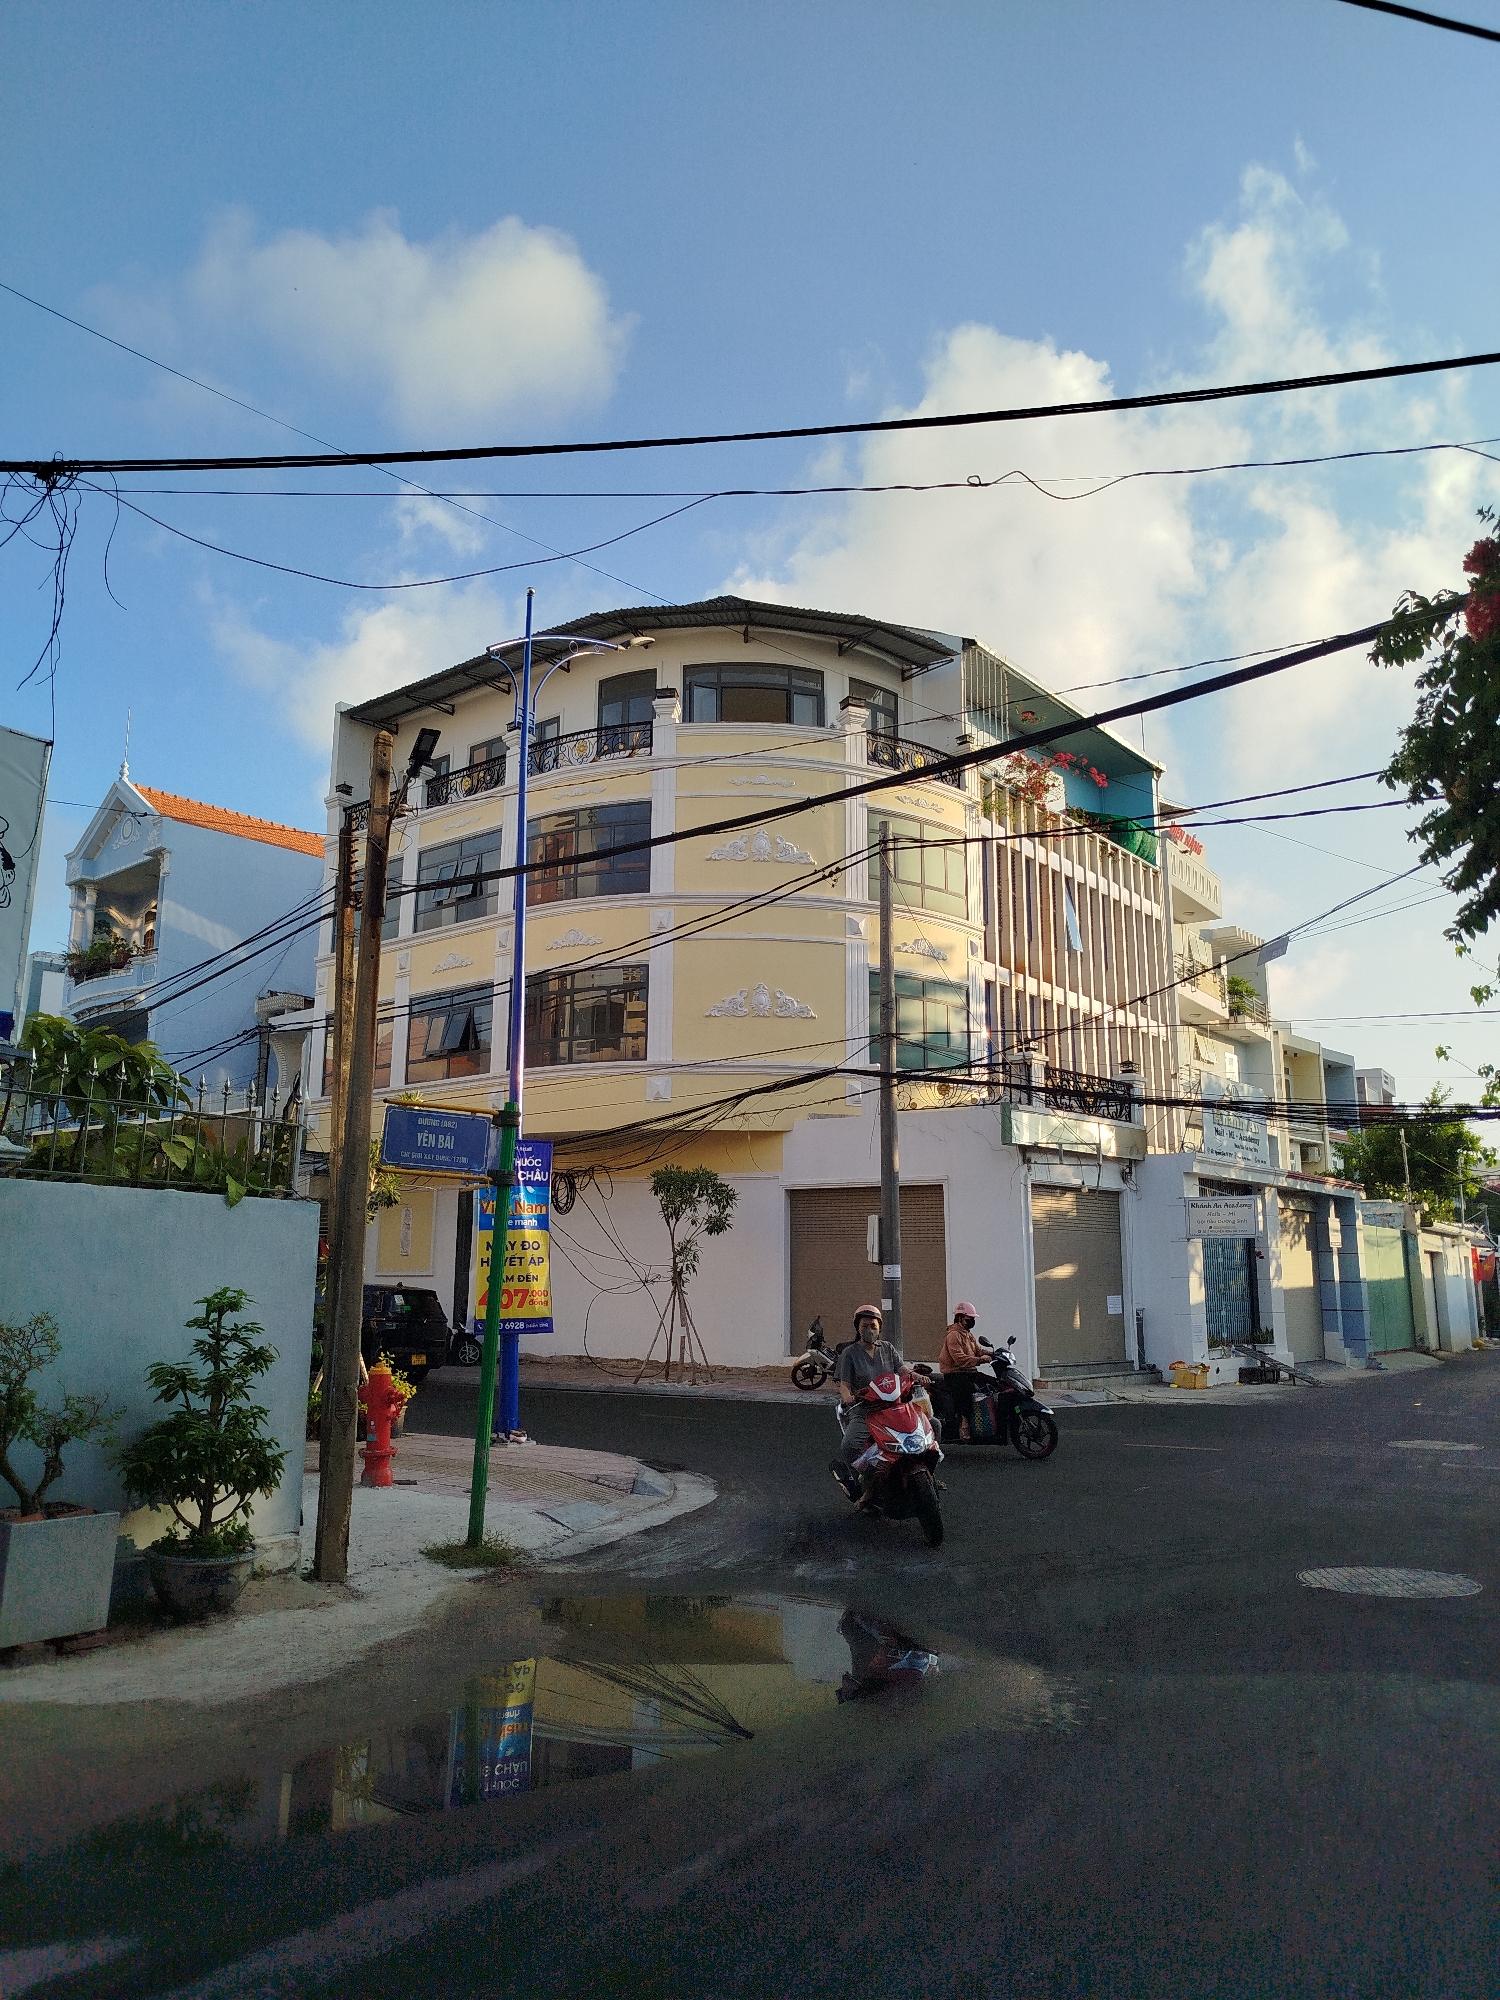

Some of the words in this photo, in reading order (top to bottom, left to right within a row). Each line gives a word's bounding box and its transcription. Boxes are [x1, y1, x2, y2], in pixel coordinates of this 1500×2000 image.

[417, 1130, 436, 1148] YÊN
[438, 1132, 455, 1149] BÁI
[514, 1155, 542, 1167] HUỐC
[518, 1169, 549, 1182] CHÂU
[515, 1200, 548, 1214] Nam
[1224, 1202, 1252, 1210] Academy
[515, 1217, 538, 1228] mạnh
[520, 1240, 541, 1251] ĐO
[480, 1252, 525, 1267] HYẾT
[528, 1253, 545, 1267] ÁP
[517, 1271, 539, 1283] ĐẾN
[504, 1321, 525, 1330] 6928
